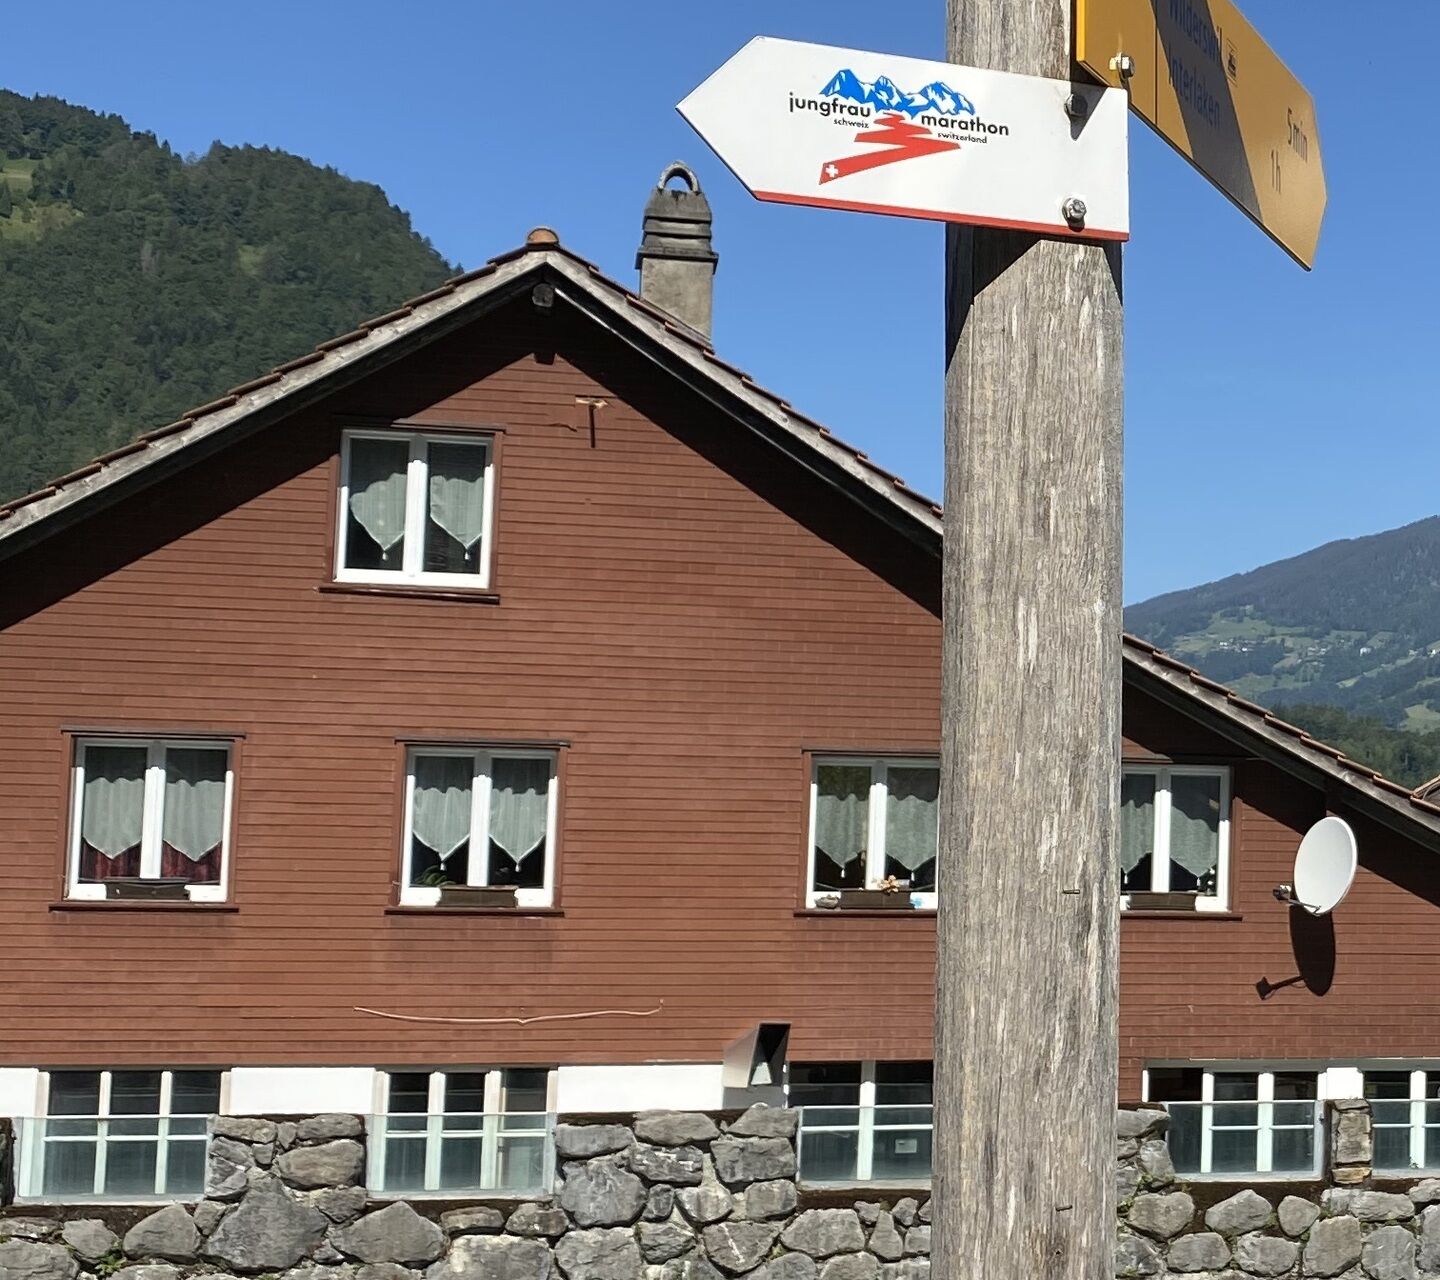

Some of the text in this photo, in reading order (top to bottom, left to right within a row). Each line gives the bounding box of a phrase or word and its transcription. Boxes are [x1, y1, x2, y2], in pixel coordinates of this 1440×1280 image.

[1168, 44, 1220, 130] Interlaken
[789, 92, 871, 118] jungfrau
[833, 118, 869, 129] schweiz
[921, 114, 1010, 136] marathon
[937, 131, 987, 144] switzerland
